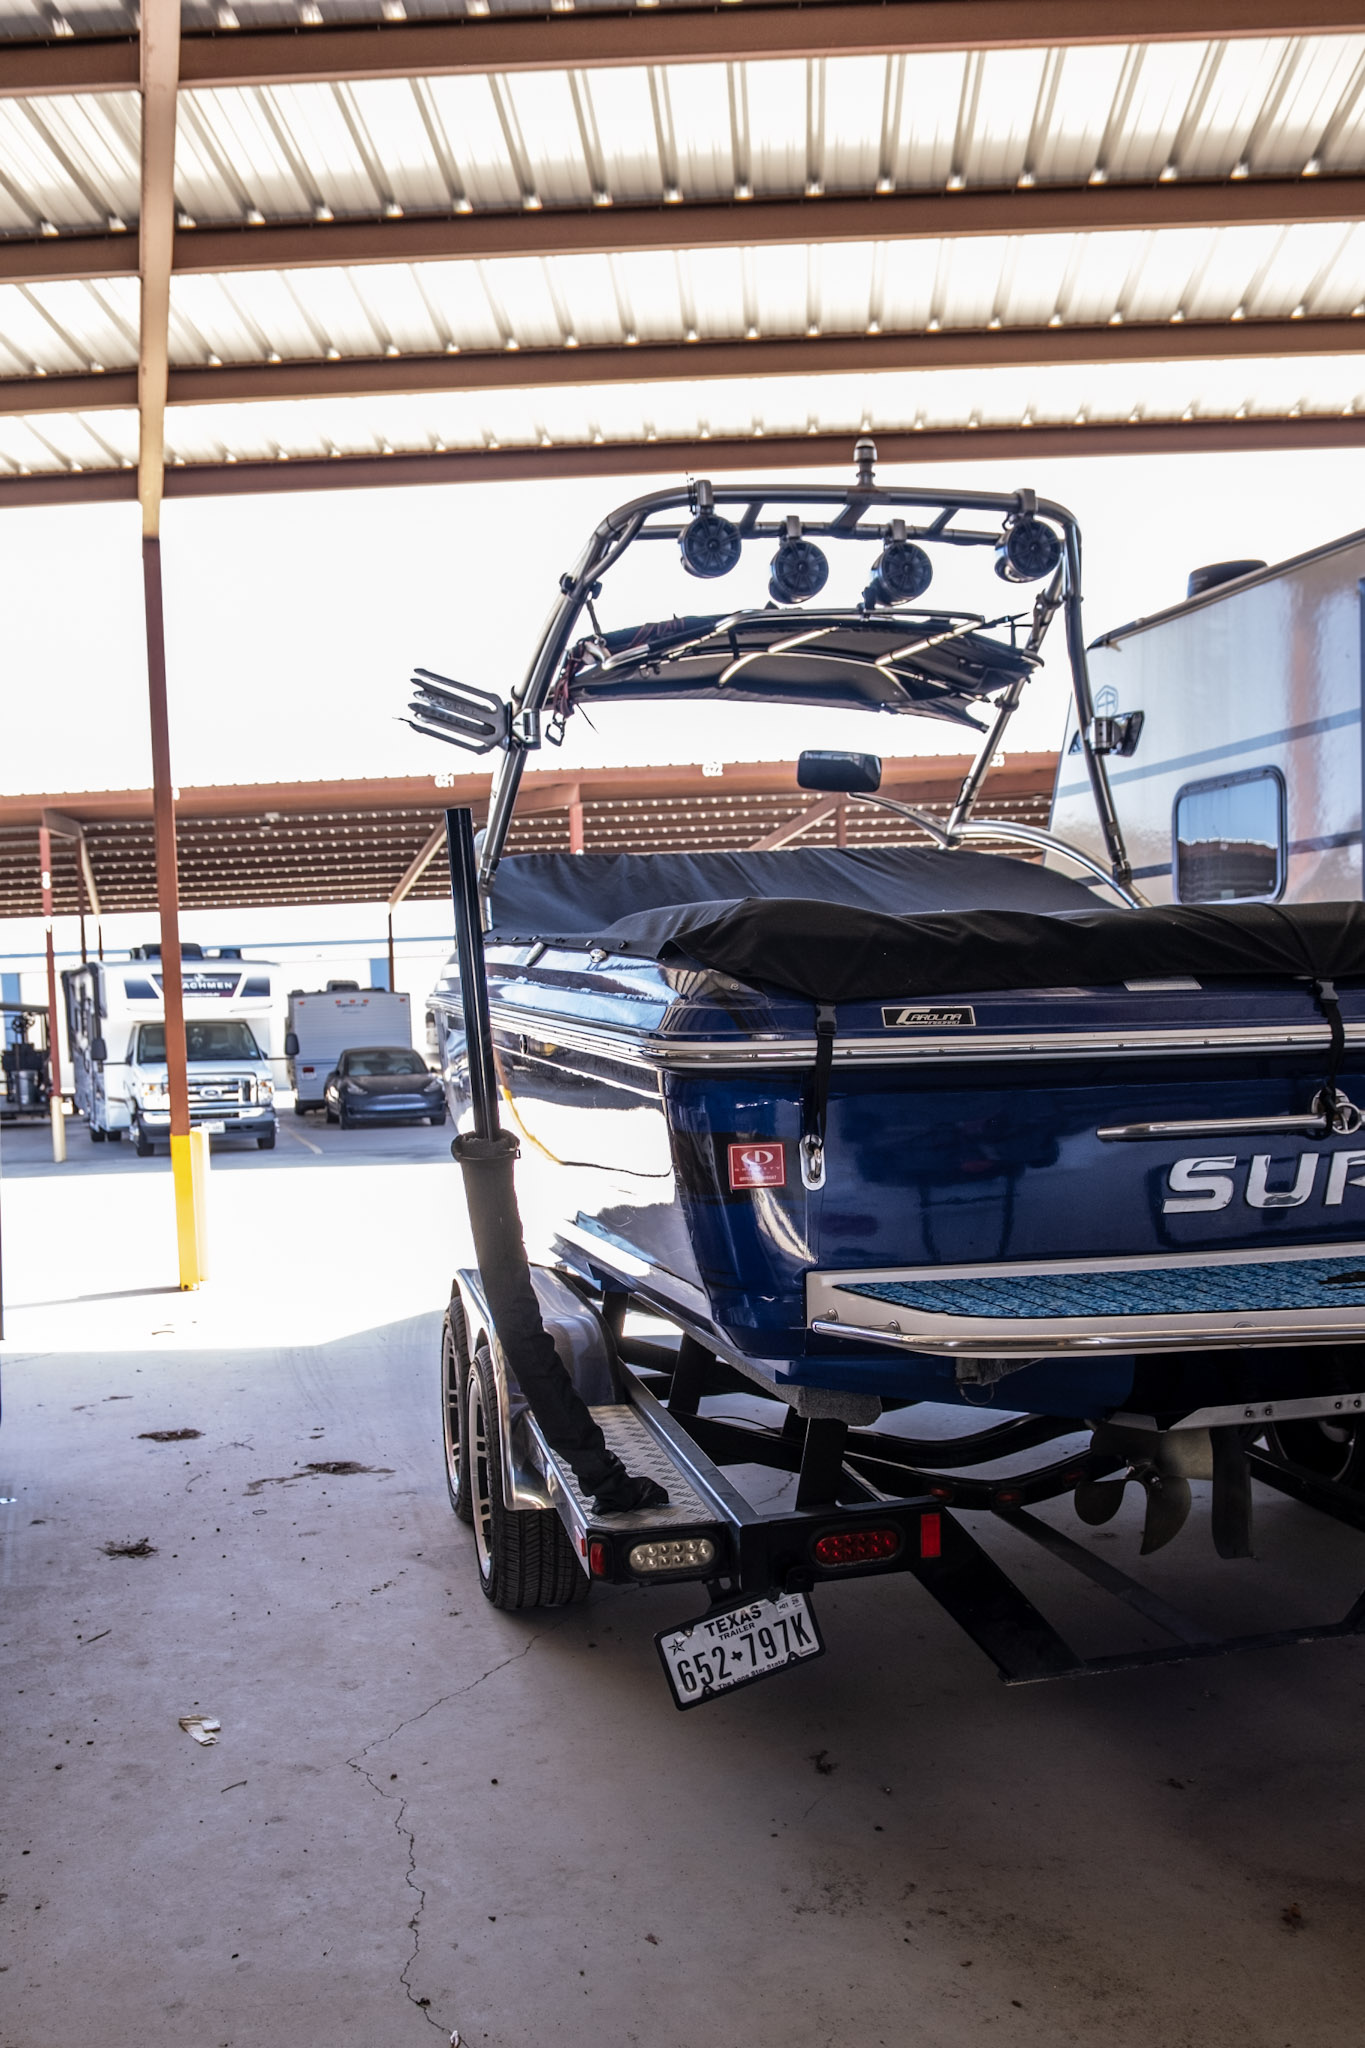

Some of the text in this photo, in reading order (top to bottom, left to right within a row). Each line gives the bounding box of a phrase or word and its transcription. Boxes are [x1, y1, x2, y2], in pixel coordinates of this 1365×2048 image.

[181, 981, 233, 990] ACHMEN
[895, 1008, 962, 1025] CAROLINA
[704, 1604, 762, 1637] TEXAS
[719, 1622, 756, 1641] TRAILER
[717, 1659, 786, 1690] The Lone Star State
